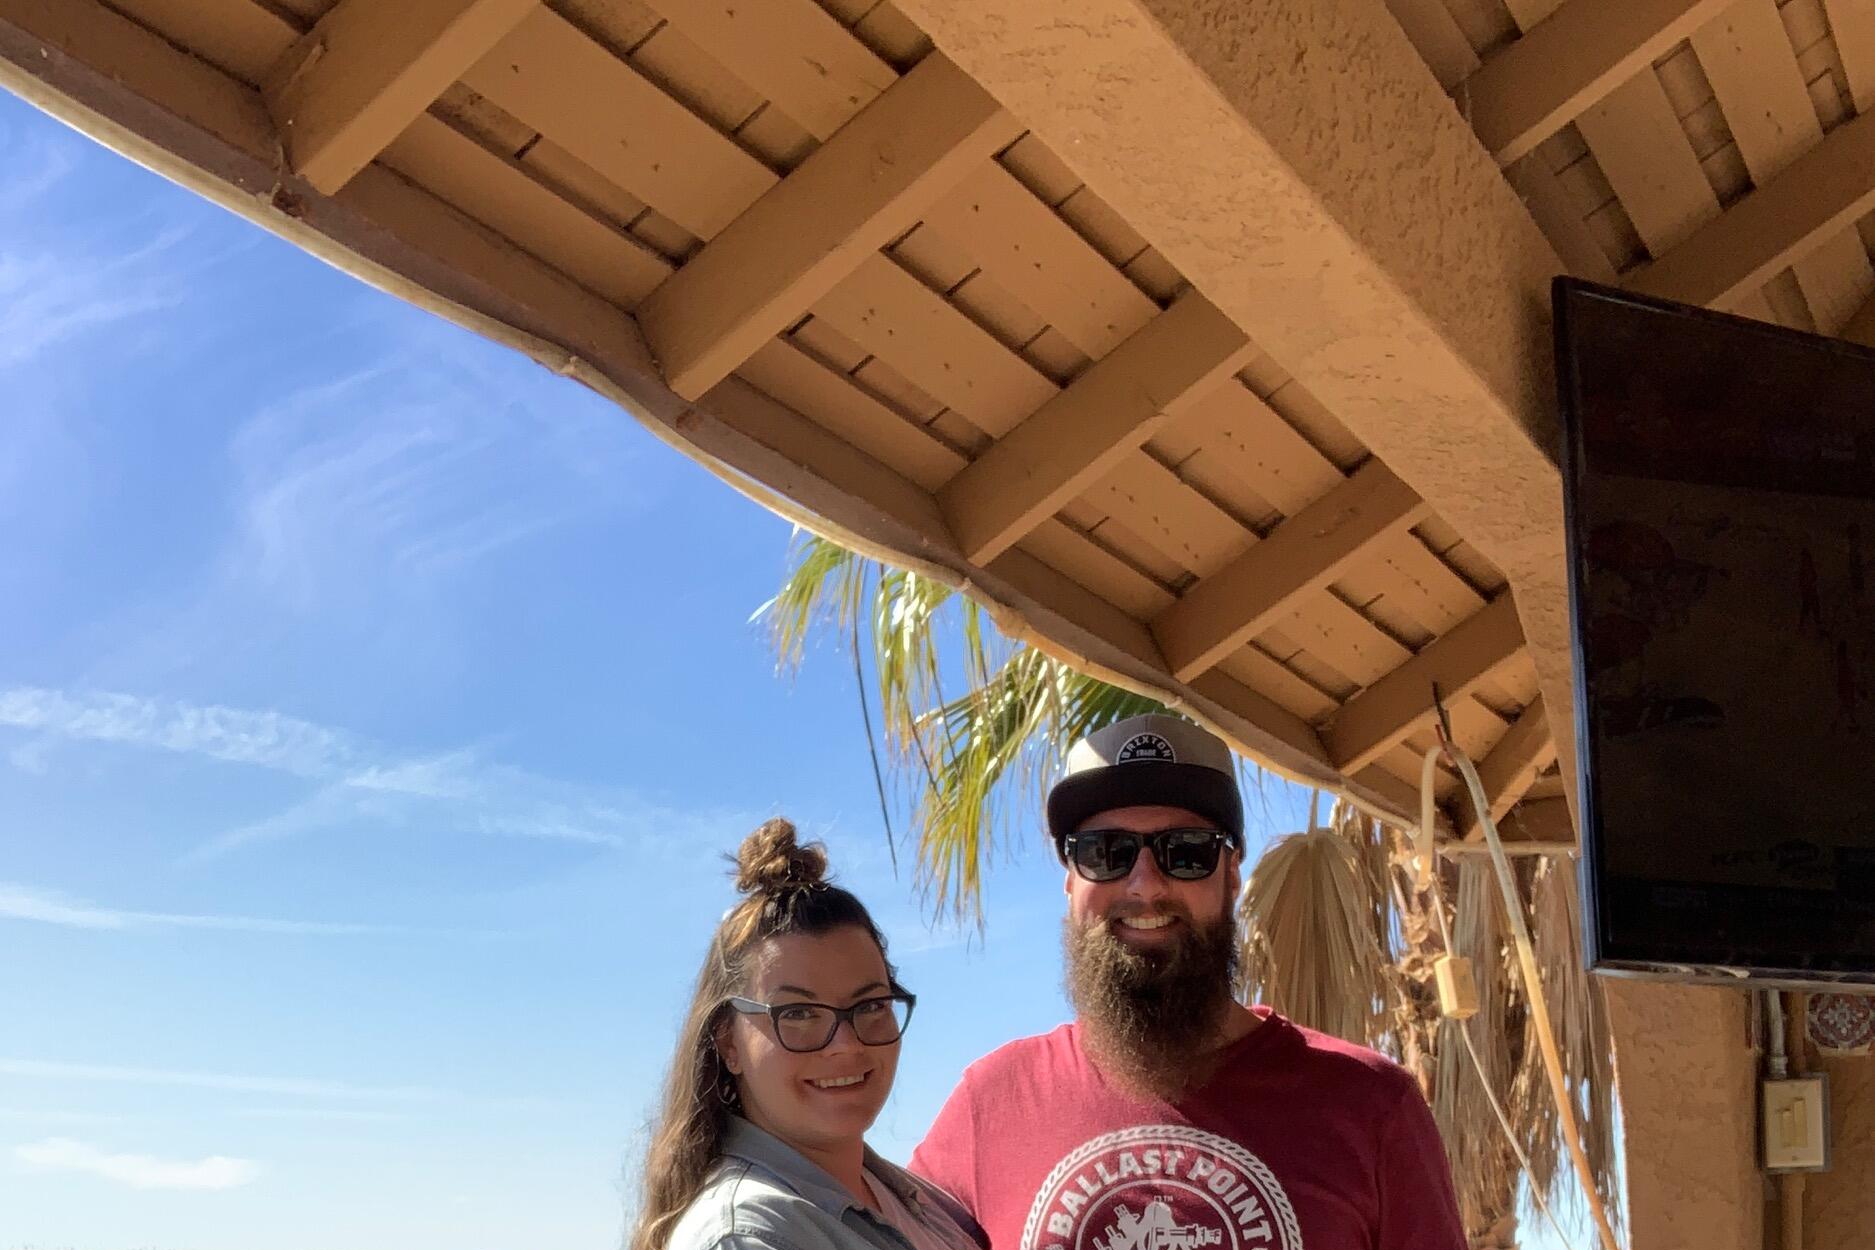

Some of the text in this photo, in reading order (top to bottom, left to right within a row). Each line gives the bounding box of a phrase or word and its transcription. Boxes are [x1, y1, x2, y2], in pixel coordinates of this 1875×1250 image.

[1122, 737, 1171, 758] BRIXTON
[1048, 1150, 1272, 1241] BALLAST POINT
